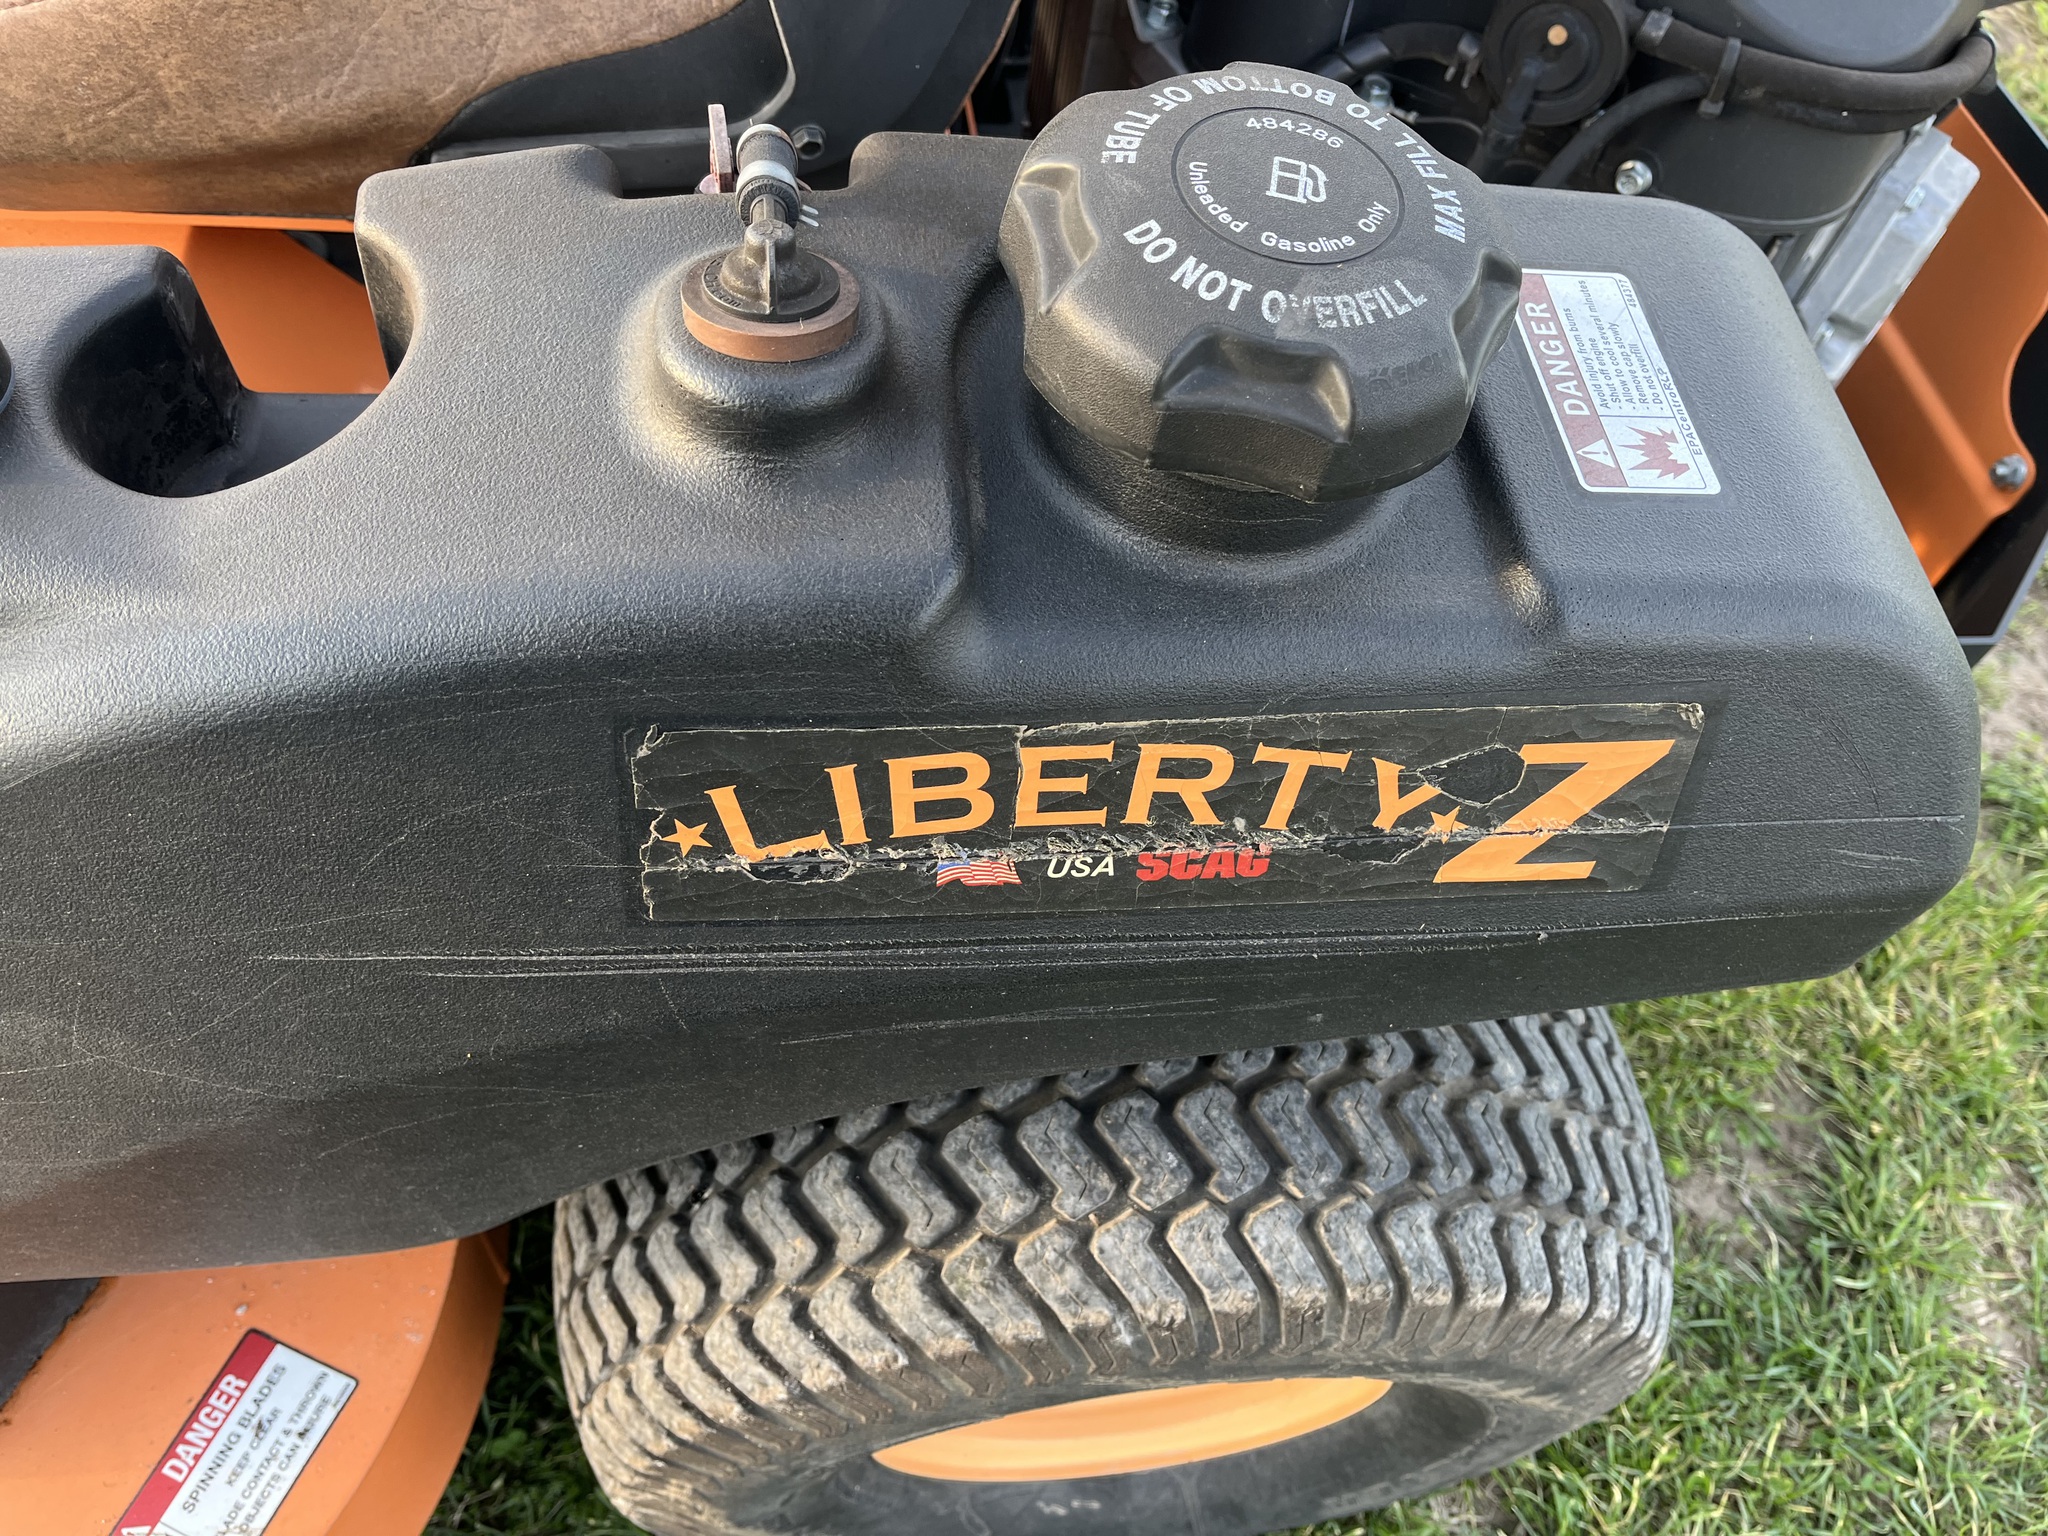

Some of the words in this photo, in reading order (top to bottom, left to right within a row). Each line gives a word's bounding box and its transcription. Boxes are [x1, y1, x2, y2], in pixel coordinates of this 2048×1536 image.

[1150, 86, 1193, 112] OF
[1192, 75, 1336, 106] BOTTOM
[1246, 117, 1344, 148] 484286
[1346, 104, 1389, 131] TO
[1100, 110, 1161, 164] TUBE
[1394, 132, 1449, 179] FILL
[1189, 162, 1250, 233] Unleaded
[1260, 231, 1356, 253] Gasoline
[1357, 201, 1391, 233] Only
[1427, 184, 1466, 243] MAX
[1123, 219, 1178, 264] DO
[1170, 255, 1253, 312] NOT
[1578, 280, 1598, 313] minutes
[1619, 279, 1637, 308] 484377
[1563, 308, 1580, 332] burns
[1590, 315, 1611, 346] several
[1573, 335, 1588, 354] from
[1588, 337, 1606, 366] engine
[1608, 322, 1626, 350] slowly
[1524, 302, 1591, 415] DANGER
[1583, 357, 1599, 381] injury
[1603, 347, 1619, 366] cool
[1620, 352, 1634, 367] cap
[1628, 343, 1649, 374] overfill
[1600, 368, 1612, 381] off
[1615, 368, 1625, 378] to
[1628, 369, 1650, 404] Remove
[1643, 375, 1657, 390] not
[1592, 384, 1611, 410] Avoid
[1606, 383, 1621, 403] Shut
[1620, 381, 1637, 405] Allow
[1652, 392, 1664, 405] Do
[704, 740, 1442, 862] LIBERTY
[1433, 739, 1676, 883] Z
[1046, 855, 1115, 879] USA
[1136, 843, 1273, 881] SCAG
[161, 1373, 248, 1483] DANGER
[182, 1430, 242, 1513] SPINNING
[237, 1363, 287, 1428] BLADES
[215, 1500, 246, 1536] LADE
[241, 1438, 284, 1499] CONTACT
[287, 1371, 329, 1424] THROWN
[225, 1450, 250, 1487] KEEP
[240, 1472, 281, 1533] OBJECTS
[278, 1443, 300, 1471] CAN
